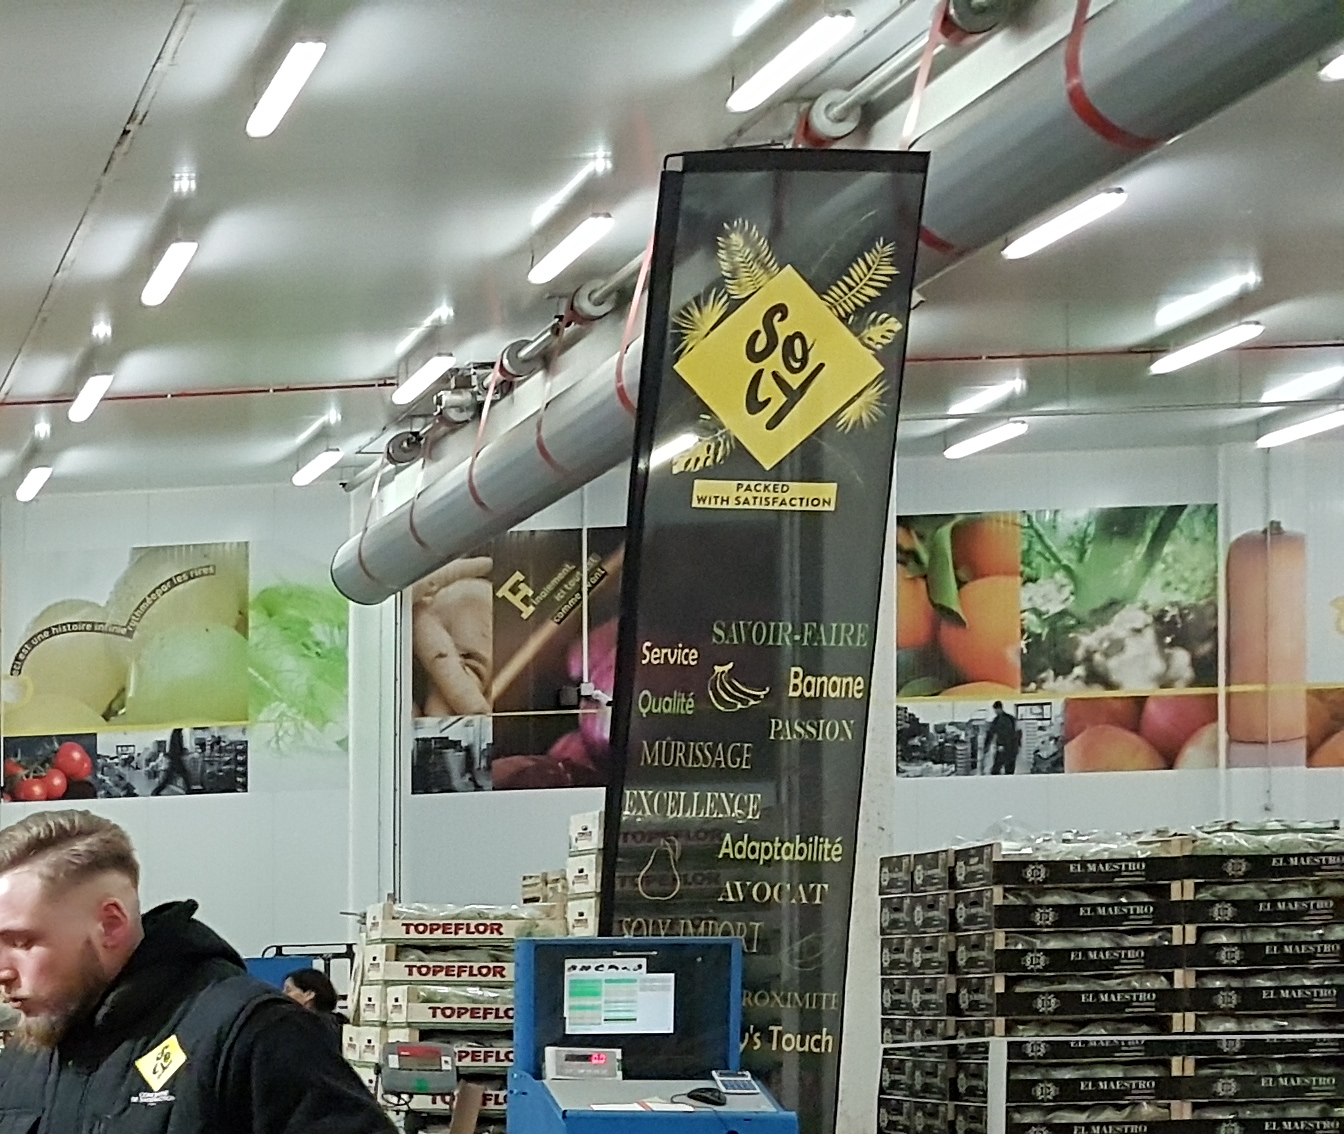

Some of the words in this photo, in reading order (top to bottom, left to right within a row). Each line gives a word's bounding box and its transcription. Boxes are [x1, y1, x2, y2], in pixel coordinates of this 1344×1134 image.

[736, 482, 790, 494] PACKED
[696, 495, 729, 507] WITH
[734, 496, 832, 508] SATISFACTION
[174, 573, 189, 585] les
[190, 566, 215, 578] rires
[554, 592, 582, 622] comme
[20, 643, 32, 660] est
[32, 630, 50, 645] une
[51, 623, 92, 636] histoire
[94, 622, 127, 635] infinie
[712, 621, 868, 647] SAVOIR-FAIRE
[641, 642, 698, 667] Service
[788, 667, 864, 699] Banane
[638, 690, 695, 716] Qualité
[769, 718, 854, 741] PASSION
[640, 736, 752, 770] MÛRISSAGE
[622, 790, 761, 820] EXCELLENCE
[718, 833, 843, 863] Adaptabilité
[1069, 863, 1082, 873] EL
[1087, 862, 1146, 872] MAESTRO
[718, 881, 828, 904] AVOCAT
[1079, 907, 1094, 916] EL
[1097, 905, 1153, 915] MAESTRO
[401, 922, 504, 936] TOPEFLOR
[1265, 945, 1280, 954] EL
[1283, 943, 1341, 954] MAESTRO
[405, 965, 506, 978] TOPEFLOR
[1081, 993, 1097, 1003] EL
[1098, 992, 1156, 1002] MAESTRO
[428, 1006, 515, 1019] TOPEFLO
[769, 1025, 833, 1053] Touch
[1080, 1081, 1096, 1090] EL
[1099, 1080, 1155, 1090] MAESTRO
[1261, 1077, 1276, 1087] EL
[1278, 1077, 1335, 1087] MAESTRO
